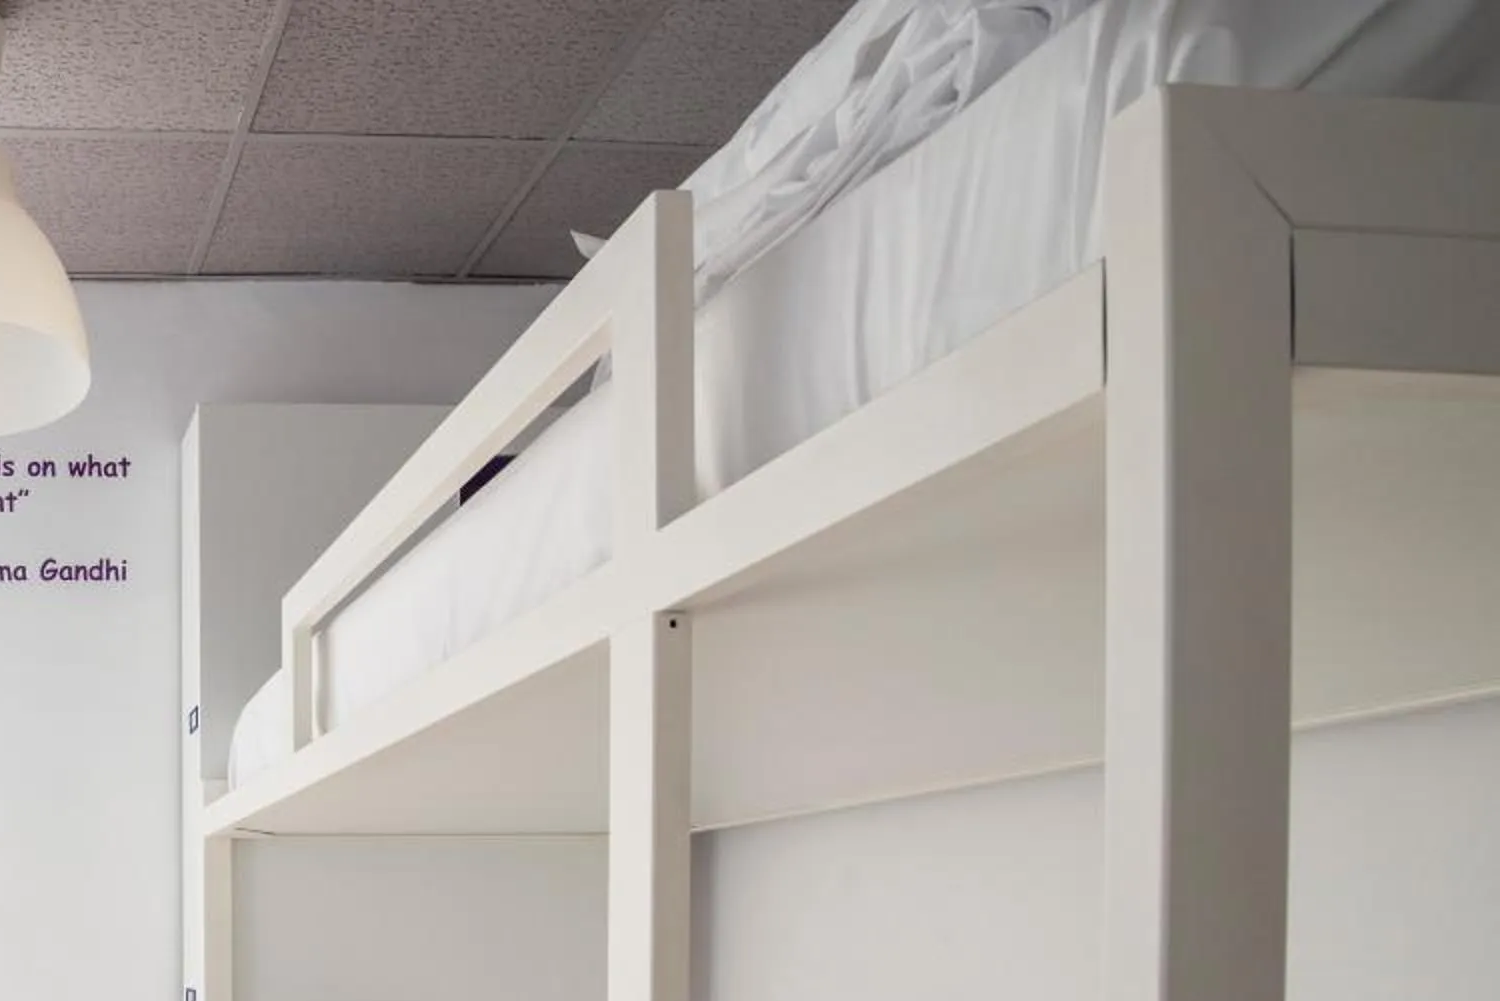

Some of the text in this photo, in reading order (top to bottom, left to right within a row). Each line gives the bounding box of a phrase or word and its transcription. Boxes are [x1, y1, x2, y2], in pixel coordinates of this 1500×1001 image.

[27, 460, 57, 478] on
[67, 454, 132, 478] what
[39, 557, 128, 582] Gandhi
